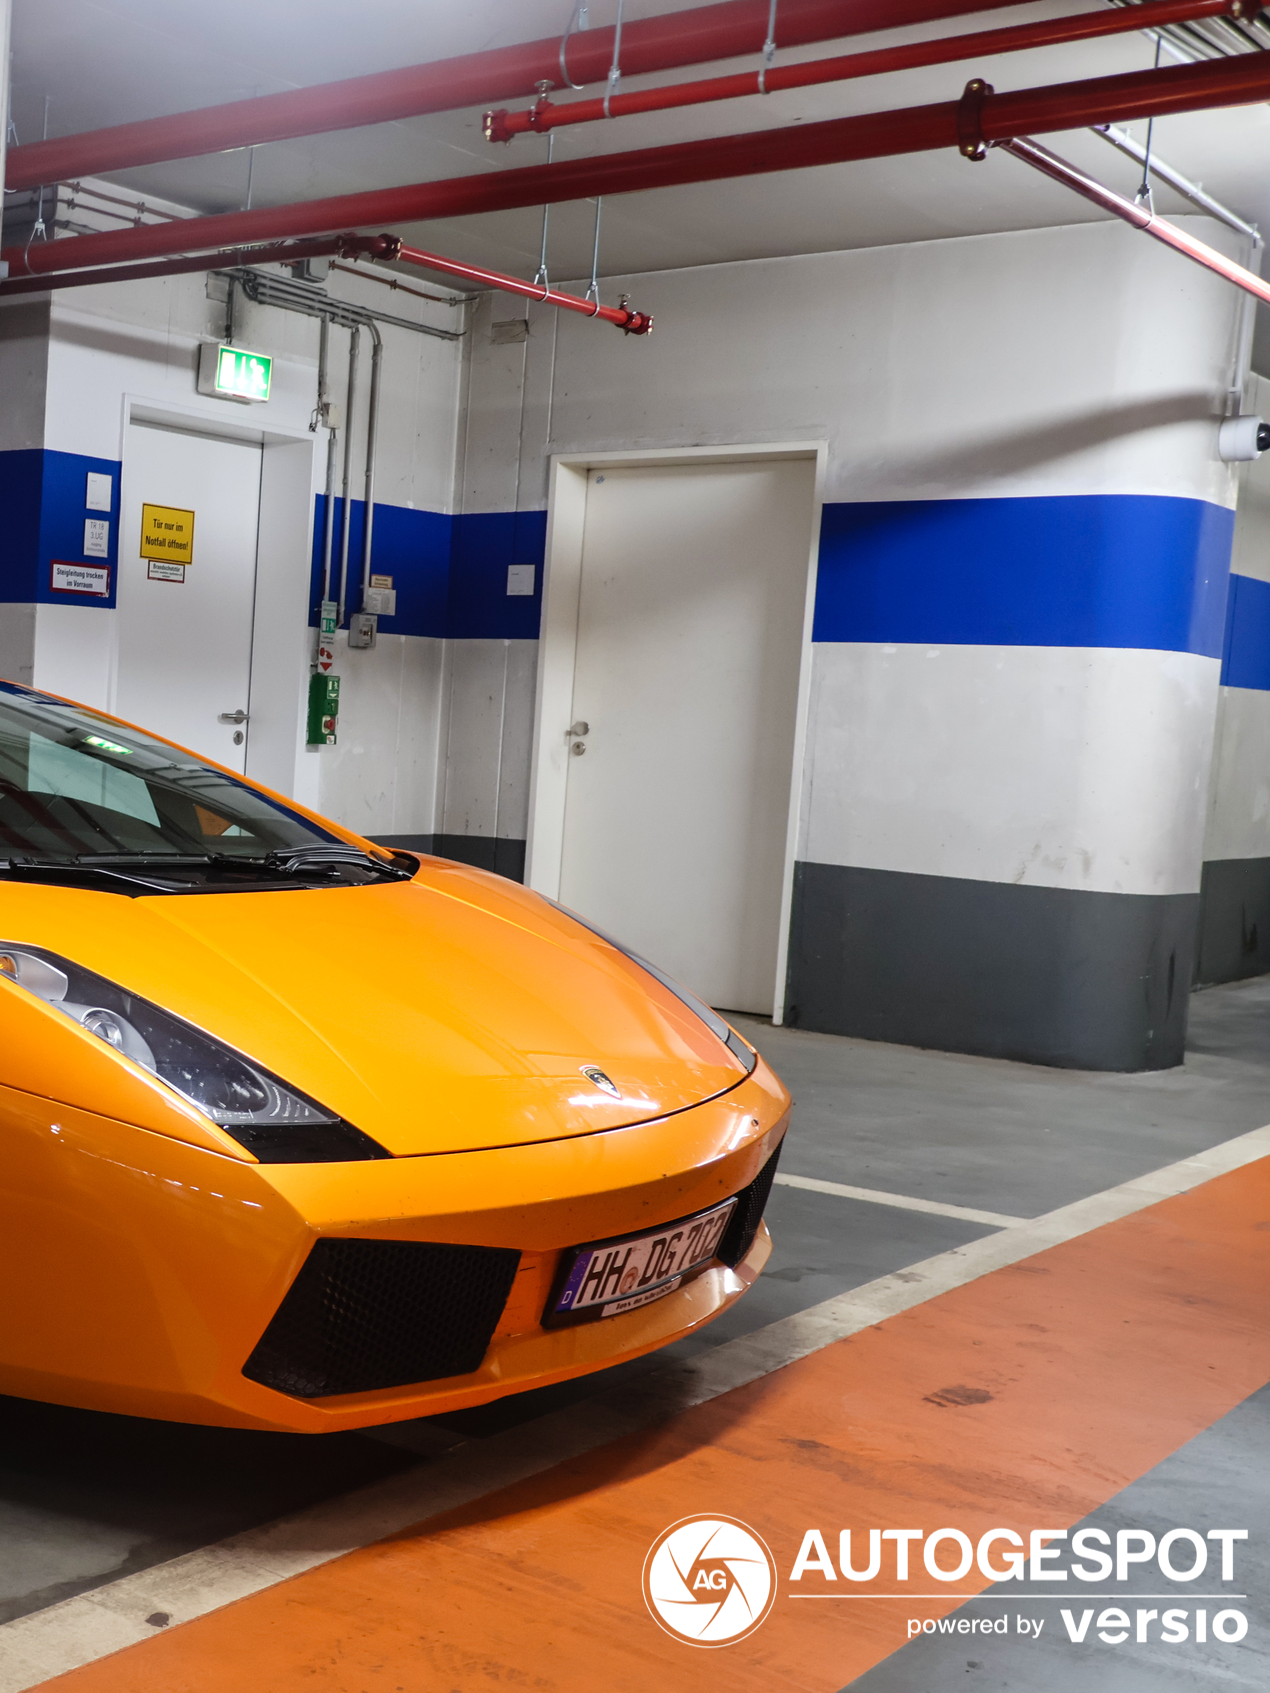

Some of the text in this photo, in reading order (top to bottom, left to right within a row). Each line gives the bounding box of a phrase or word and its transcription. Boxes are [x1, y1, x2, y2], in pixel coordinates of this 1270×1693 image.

[153, 518, 183, 532] Tür nur im
[145, 535, 189, 551] Notfall öffnen!
[56, 567, 104, 580] Steigleitung trocken
[66, 579, 93, 588] im Vorraum
[577, 1247, 633, 1304] HH
[637, 1231, 684, 1288] DG
[677, 1211, 728, 1271] 702
[561, 1290, 573, 1304] D
